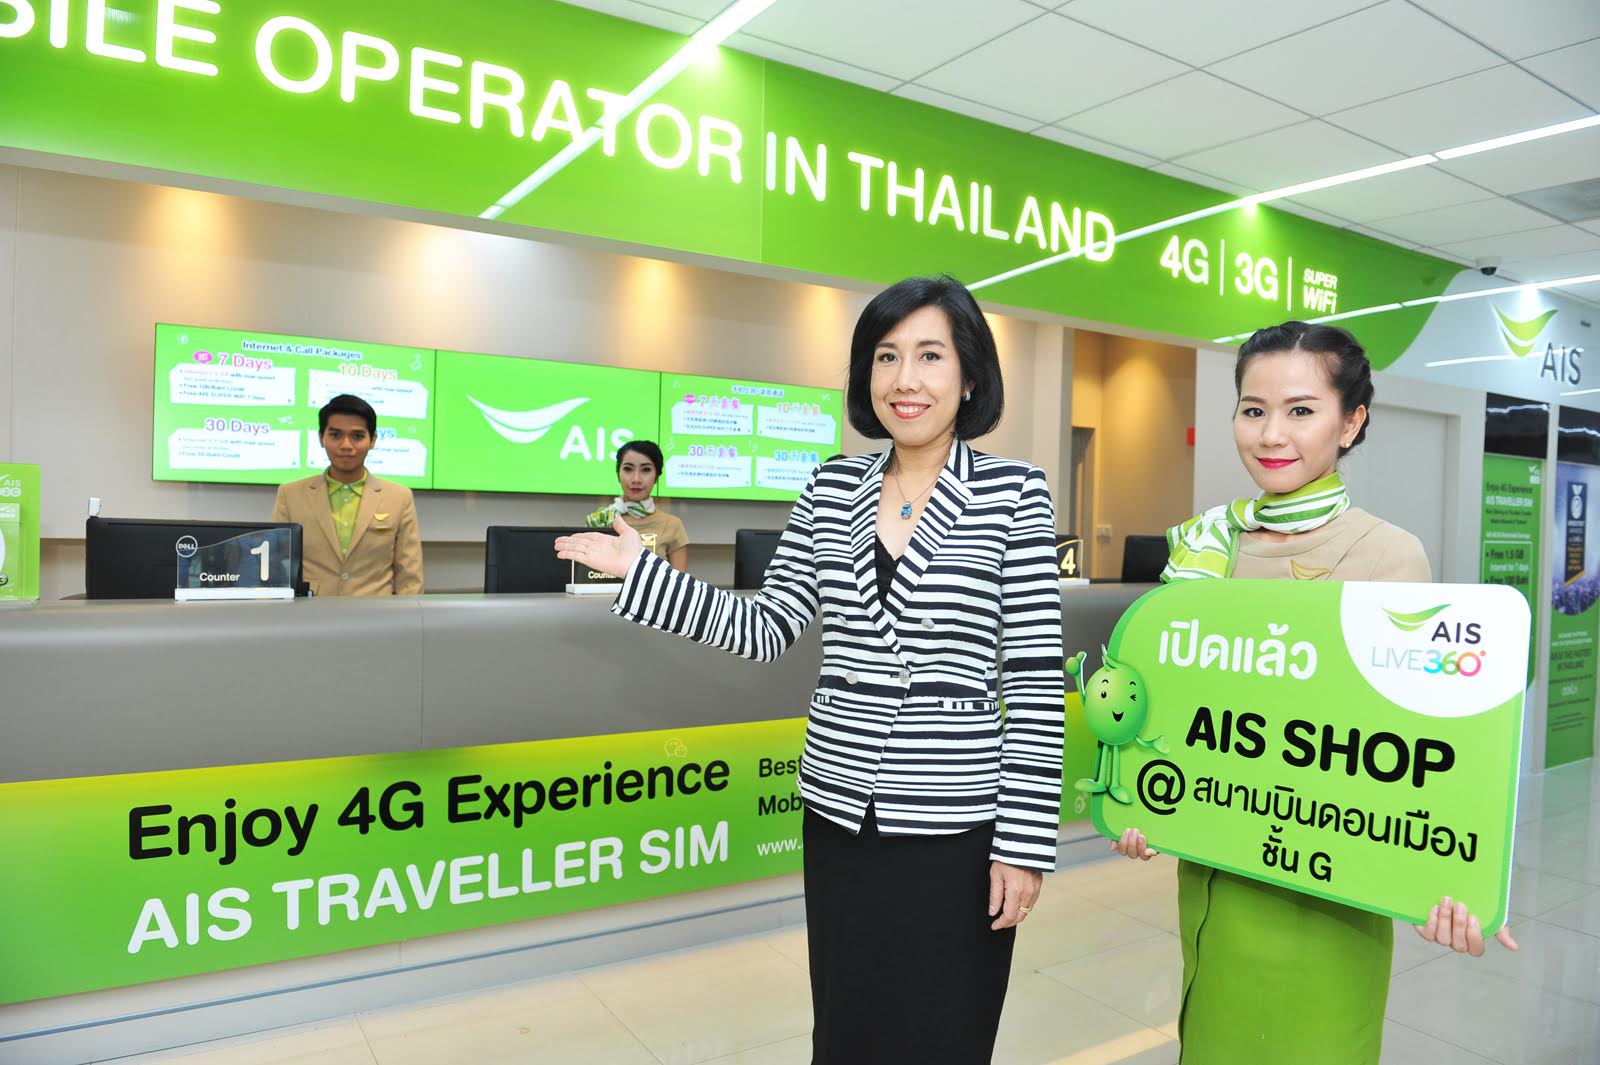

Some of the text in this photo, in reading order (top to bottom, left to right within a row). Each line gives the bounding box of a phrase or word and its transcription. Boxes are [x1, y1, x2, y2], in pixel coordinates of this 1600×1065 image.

[254, 15, 743, 184] OPERATOR
[765, 131, 828, 202] IN
[847, 150, 1117, 264] THAILAND
[1159, 234, 1279, 302] 4G 3G
[1303, 267, 1338, 290] SUPER
[1303, 285, 1338, 315] WiFi
[218, 353, 229, 366] 7
[233, 355, 273, 372] Days
[243, 341, 283, 352] Internet
[295, 345, 313, 354] Call
[316, 347, 362, 360] Packages
[1540, 342, 1582, 385] AIS
[339, 364, 397, 381] 10 Days
[205, 418, 270, 436] 30 Days
[559, 424, 635, 462] AIS
[4, 479, 22, 488] AIS
[199, 572, 241, 582] Counter
[250, 540, 270, 582] 1
[1060, 547, 1076, 575] 4
[1157, 618, 1319, 681] เปิดแล้ว
[1430, 620, 1483, 646] AIS
[1185, 706, 1456, 789] AIS SHOP
[128, 759, 731, 866] Enjoy 4G Experience
[758, 791, 803, 817] Mob
[1135, 758, 1479, 864] @ สนามบินดอนเมือง
[1261, 824, 1333, 884] ชั้น G
[126, 820, 731, 956] AIS TRAVELLER SIM
